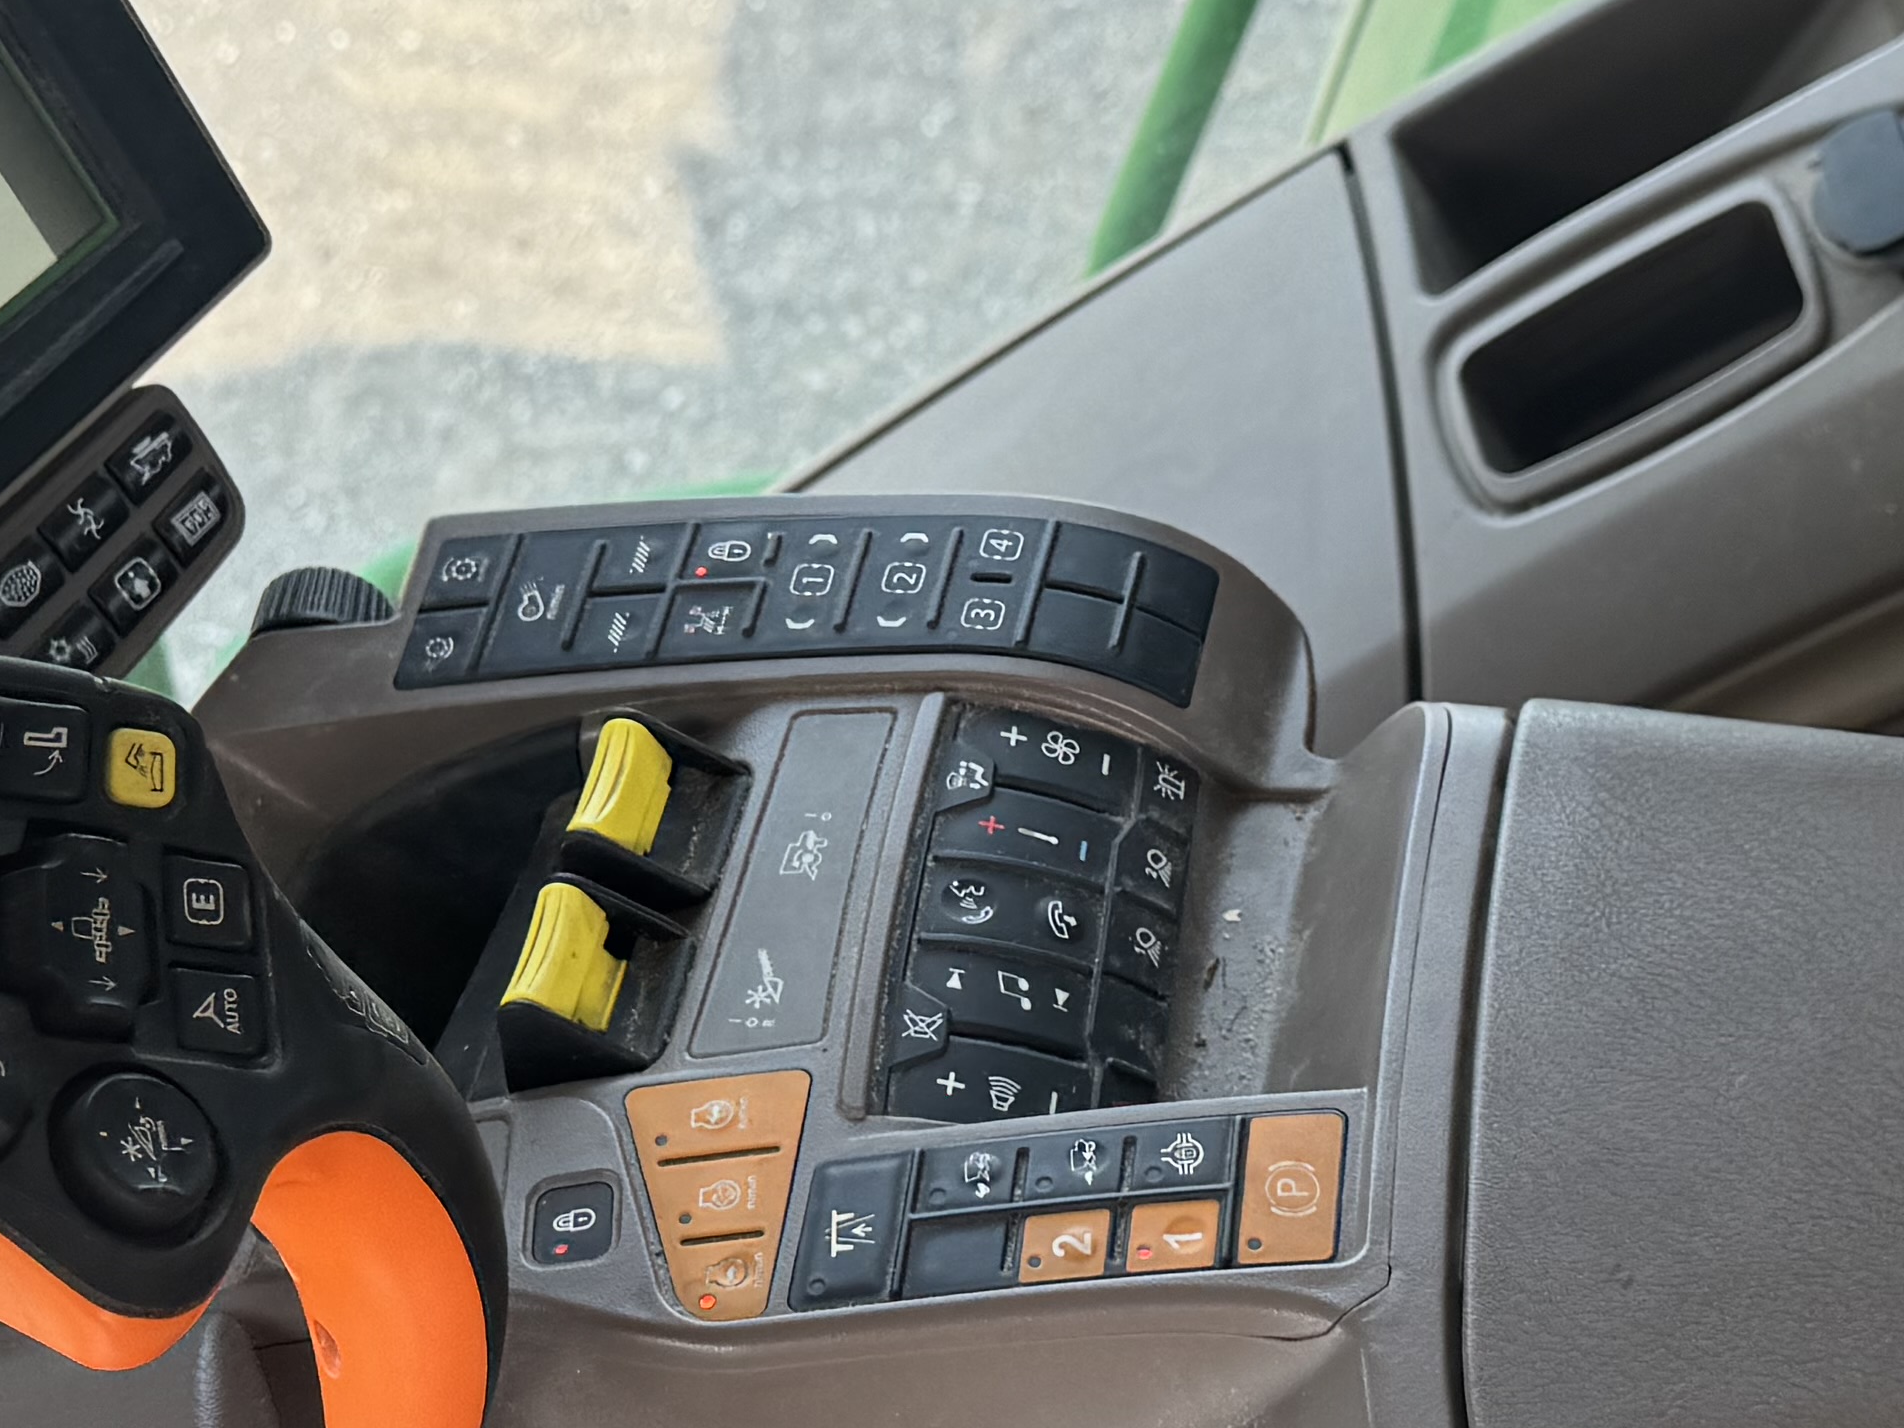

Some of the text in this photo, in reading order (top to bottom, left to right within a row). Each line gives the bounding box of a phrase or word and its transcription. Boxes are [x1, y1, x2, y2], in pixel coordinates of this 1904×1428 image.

[989, 538, 1013, 553] 4
[892, 572, 917, 585] 2
[970, 608, 996, 621] 3
[191, 891, 216, 911] E
[223, 988, 242, 1035] AUTO
[1276, 1178, 1309, 1198] P
[1051, 1232, 1092, 1258] 2
[1162, 1232, 1203, 1250] 1
